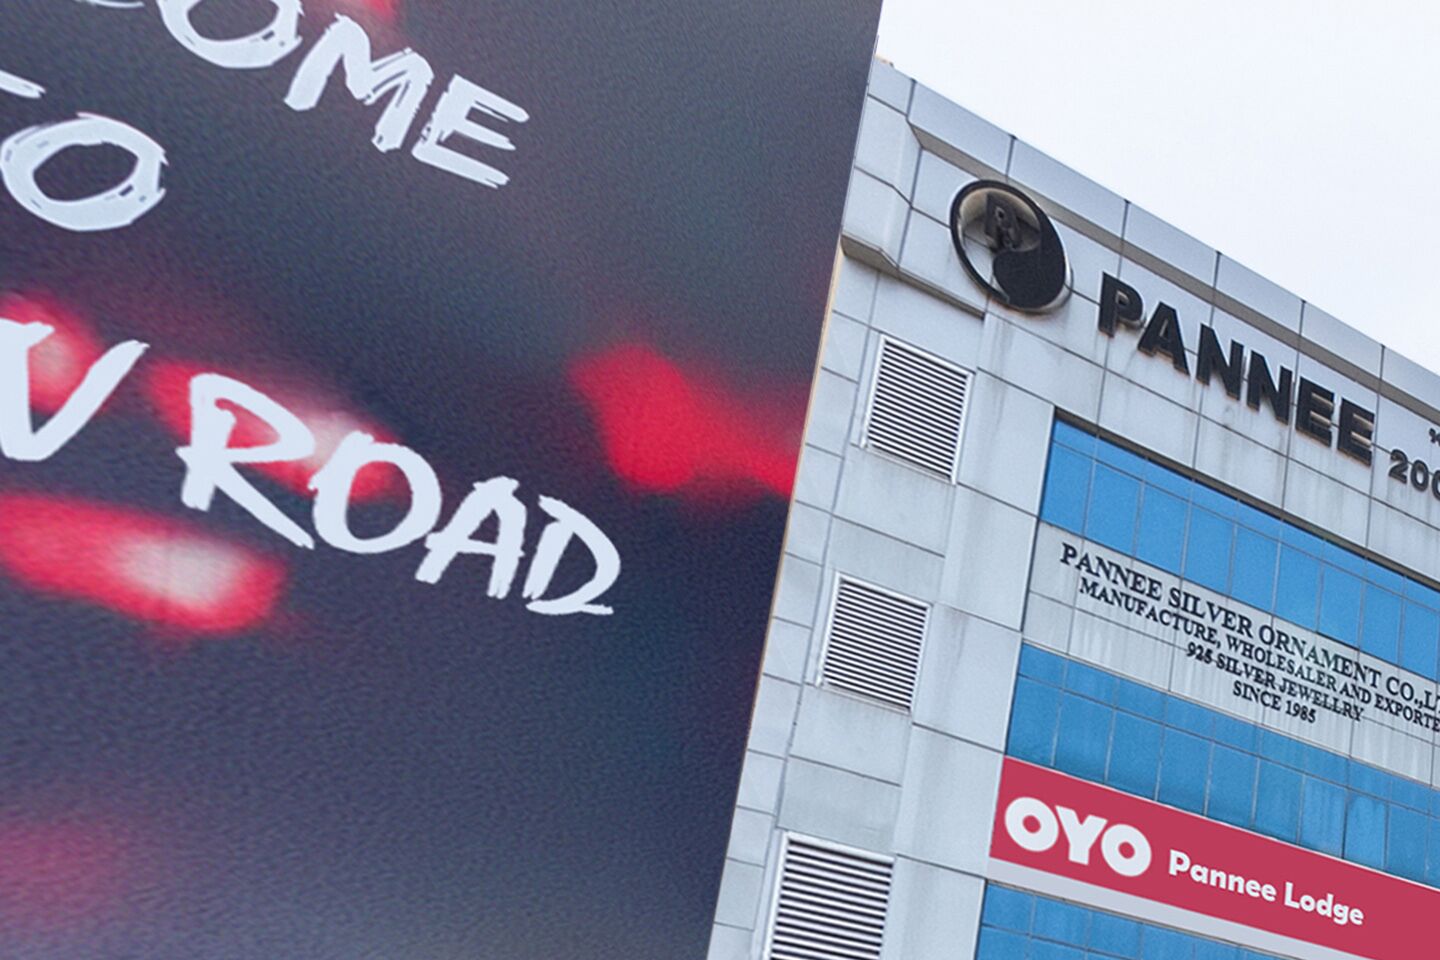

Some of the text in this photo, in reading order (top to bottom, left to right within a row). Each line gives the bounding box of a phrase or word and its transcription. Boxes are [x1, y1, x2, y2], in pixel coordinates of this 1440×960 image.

[88, 0, 529, 188] OME
[1098, 271, 1375, 465] PANNEE
[176, 373, 622, 616] ROAD
[1060, 542, 1163, 601] PANNEE
[1168, 586, 1254, 639] SILVER
[1258, 625, 1382, 689] ORNAMENT
[1079, 577, 1221, 649] MANUFACTURE,
[1226, 634, 1337, 692] WHOLESALER
[1336, 682, 1371, 705] AND
[1186, 642, 1364, 722] 925 SILVER JEWELLRY
[1233, 680, 1317, 724] SINCE 1985
[1004, 796, 1152, 877] OYO
[1168, 850, 1365, 927] Pannee Lodge
